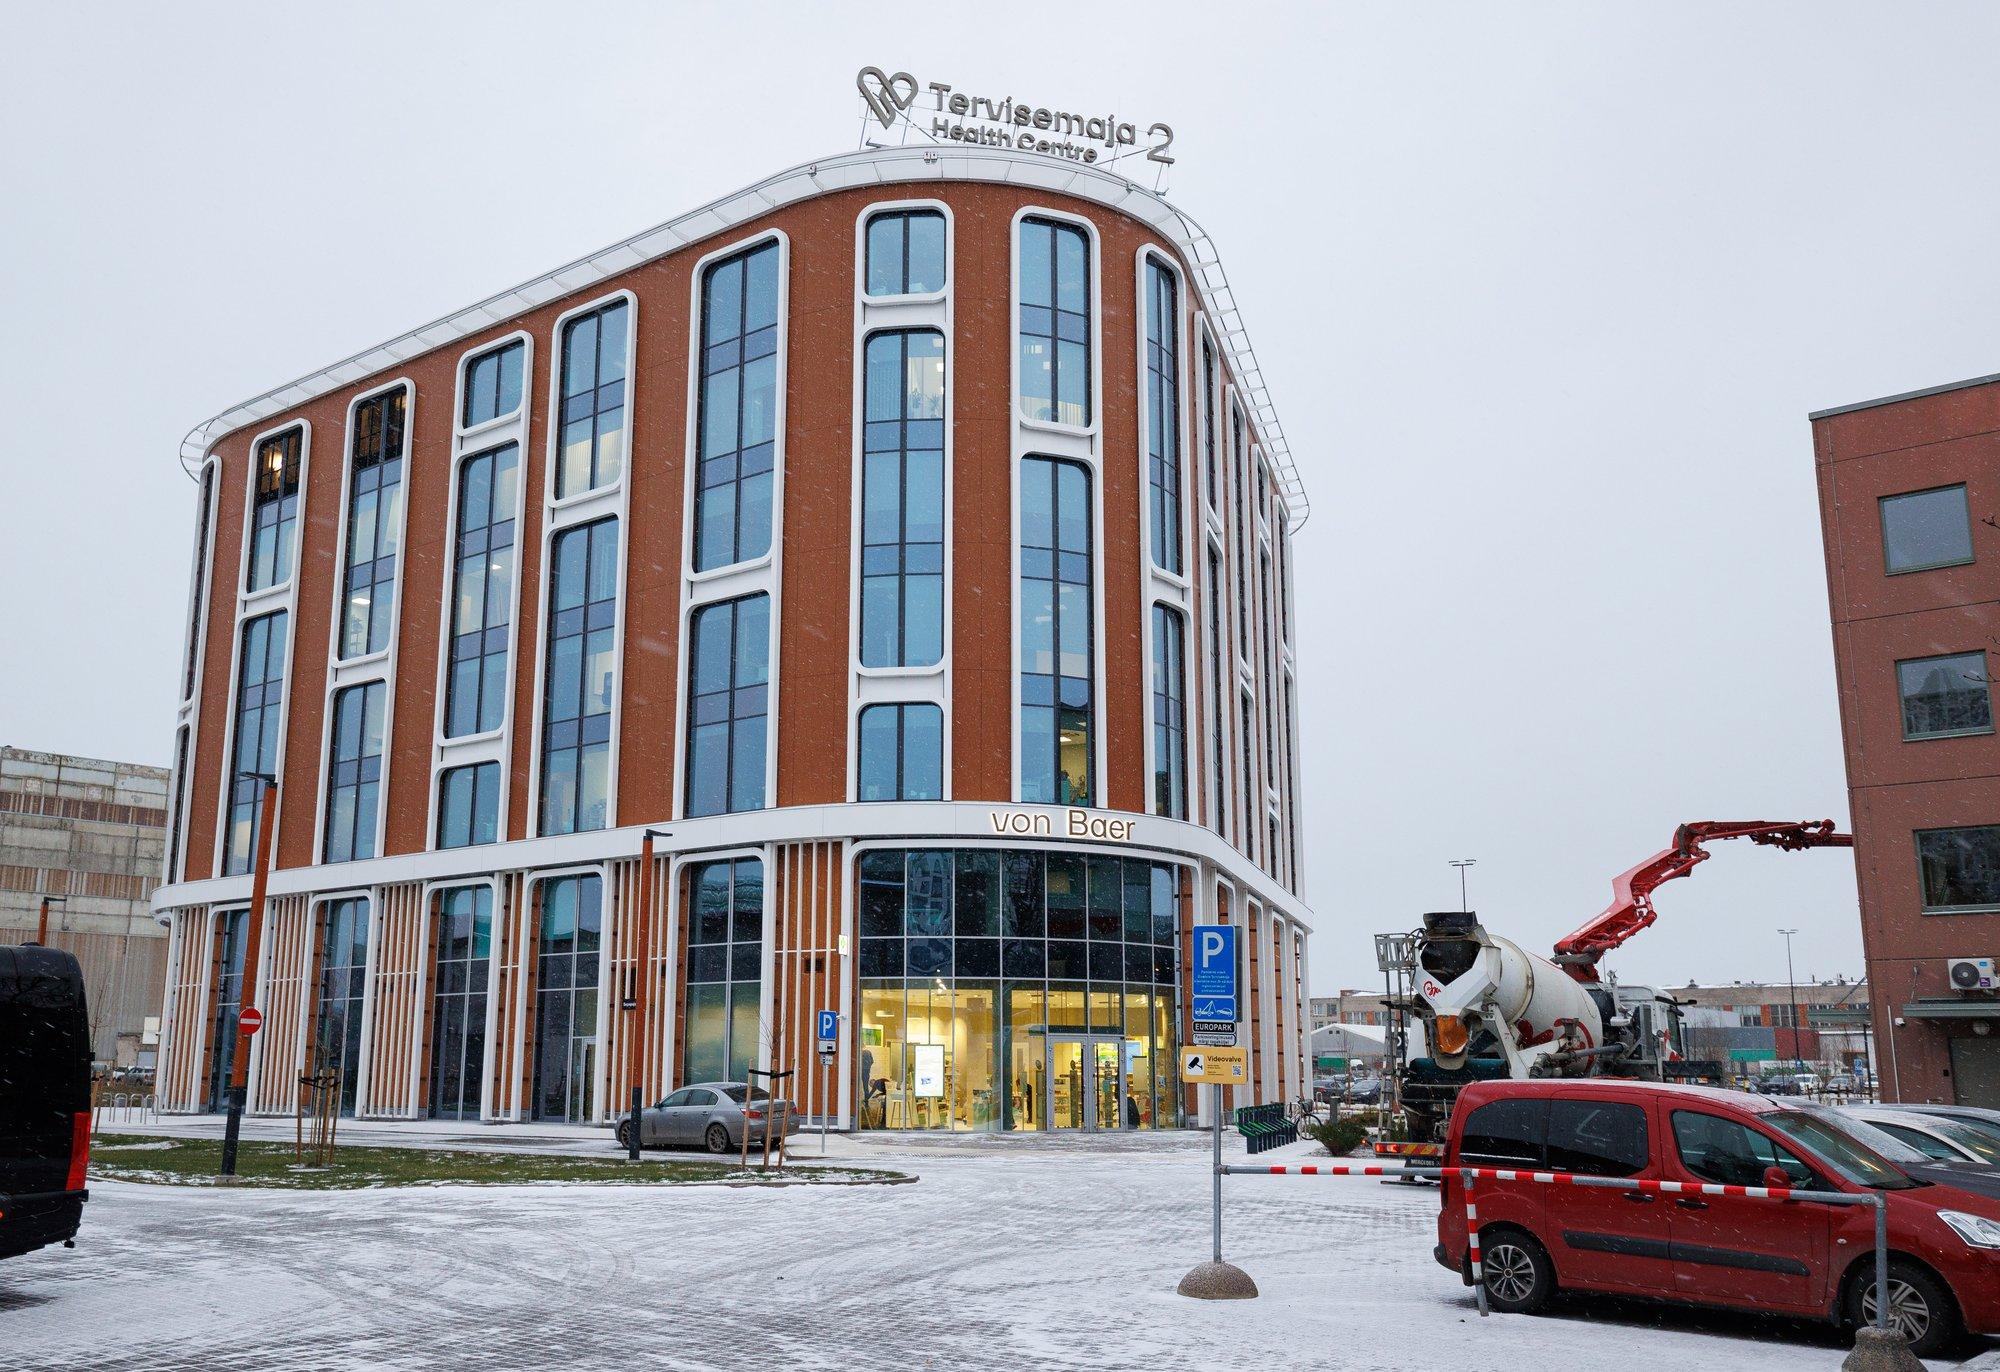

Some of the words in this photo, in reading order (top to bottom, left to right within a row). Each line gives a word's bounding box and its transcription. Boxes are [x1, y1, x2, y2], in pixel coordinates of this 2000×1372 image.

[929, 82, 1136, 149] Tervisemaja
[1147, 122, 1176, 165] 2
[932, 116, 1013, 148] Health
[1017, 132, 1098, 164] Centre
[992, 812, 1051, 834] von
[1068, 809, 1136, 841] Baer
[1202, 931, 1224, 968] P
[823, 1014, 833, 1036] P
[1195, 1023, 1232, 1031] EUROPARK
[1207, 1055, 1242, 1063] Videovalve
